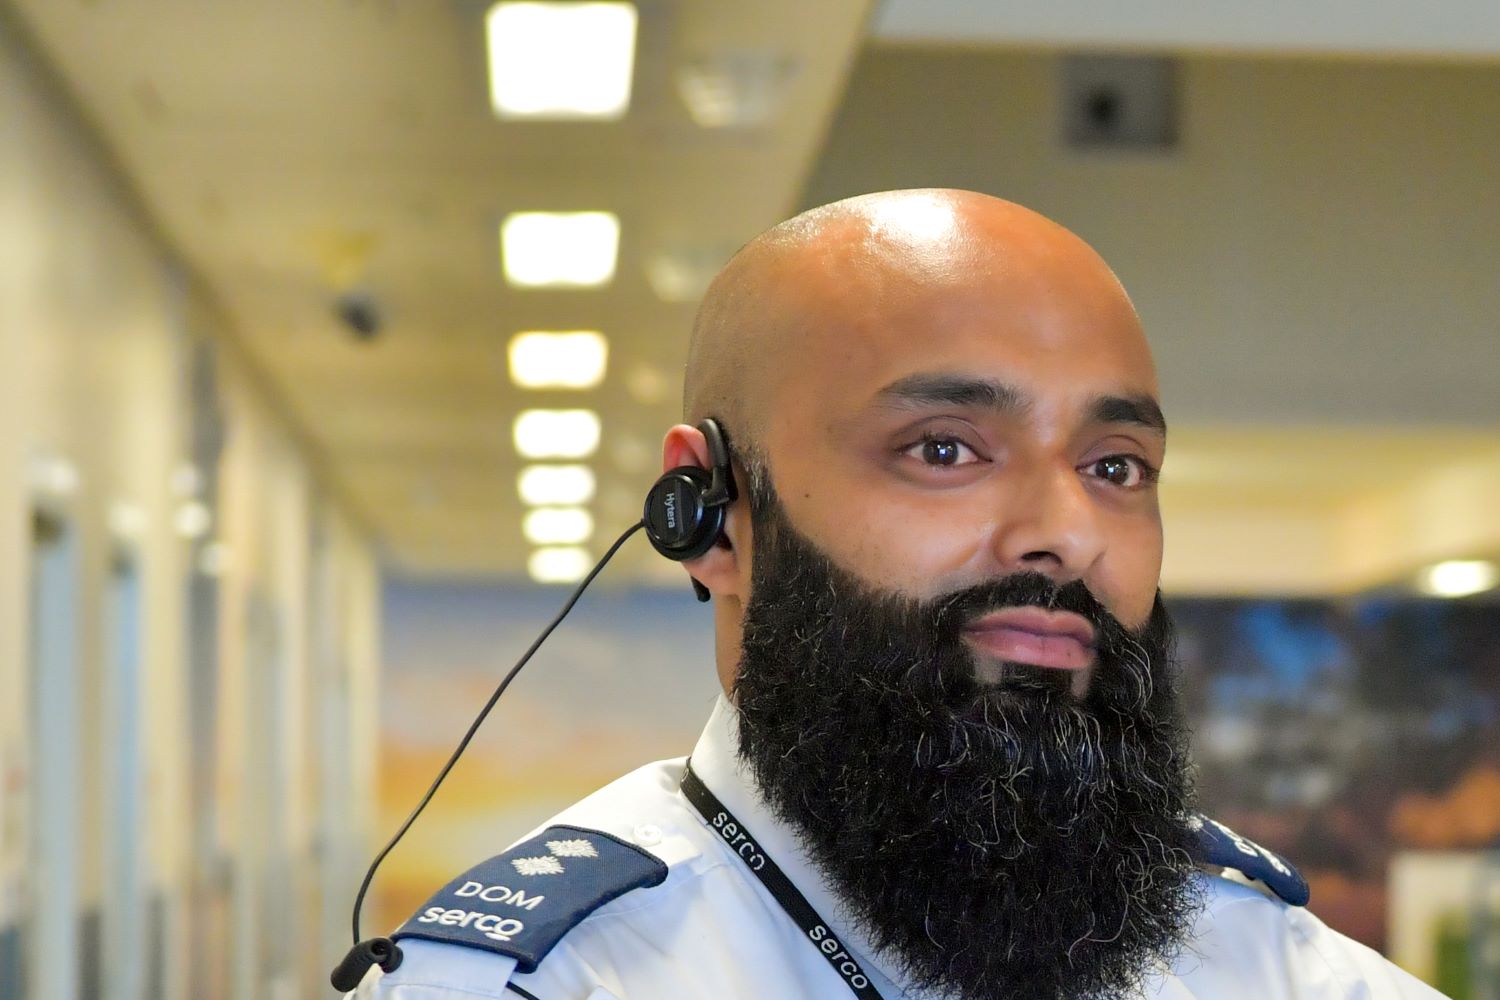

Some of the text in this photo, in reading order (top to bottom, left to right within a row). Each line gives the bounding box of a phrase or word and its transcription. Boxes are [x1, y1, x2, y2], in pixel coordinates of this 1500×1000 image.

[664, 493, 676, 529] Hytera
[713, 812, 765, 871] serco
[454, 881, 545, 910] DOM
[418, 906, 524, 941] serco
[809, 925, 868, 989] serco
